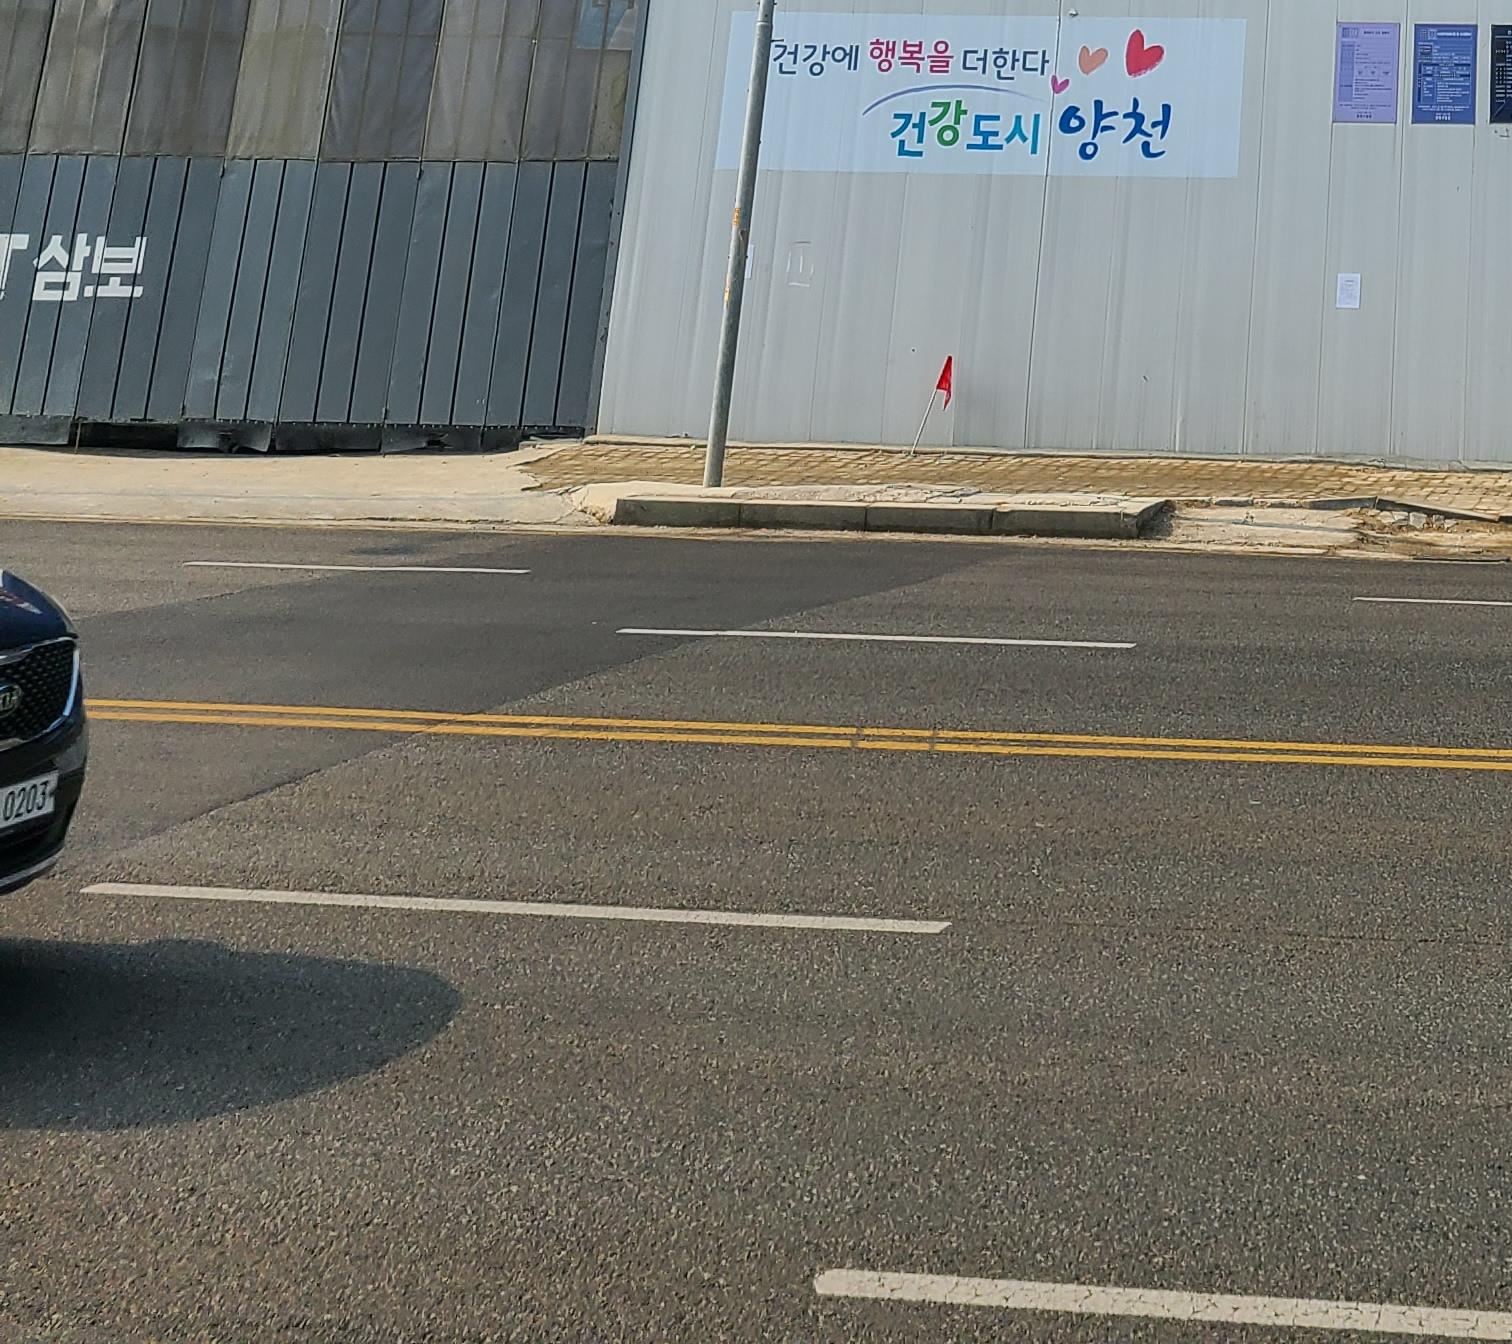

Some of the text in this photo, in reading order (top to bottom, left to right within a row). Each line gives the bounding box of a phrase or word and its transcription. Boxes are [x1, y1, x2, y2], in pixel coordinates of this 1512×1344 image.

[772, 38, 1050, 81] 건강에 행복을 더한다
[890, 98, 1172, 161] 건강도시 양천
[3, 780, 49, 821] 0203
